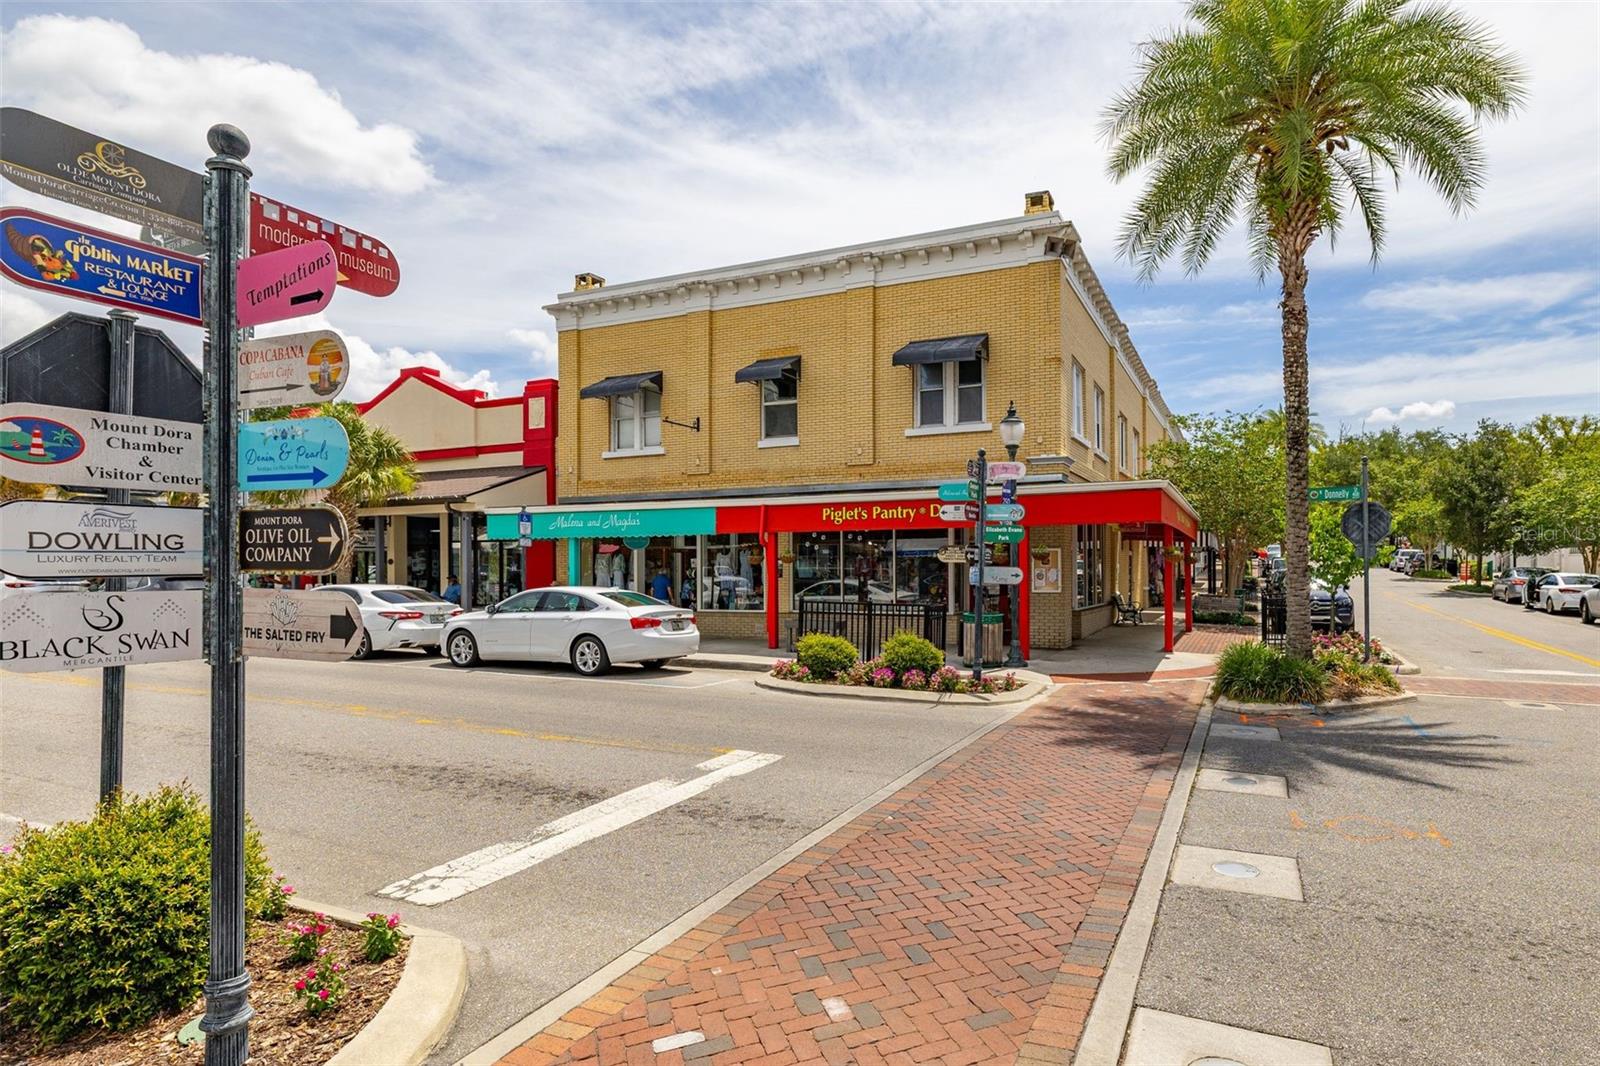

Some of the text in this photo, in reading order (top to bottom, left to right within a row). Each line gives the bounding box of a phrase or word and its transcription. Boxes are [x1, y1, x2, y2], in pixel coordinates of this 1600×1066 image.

[57, 162, 162, 204] OLDE MOUNT DORA
[73, 176, 147, 206] Carriage Company
[79, 235, 91, 245] the
[340, 252, 391, 280] museum
[85, 262, 186, 296] RESTAURANT
[247, 252, 331, 306] Temptations
[108, 279, 168, 301] & LOUNGE
[240, 345, 304, 366] COPACABANA
[90, 418, 192, 440] Mount Dora
[106, 436, 184, 455] Chamber
[245, 440, 328, 466] Denim & Pearls
[139, 455, 152, 468] &
[85, 466, 202, 485] Visitor Center
[79, 512, 138, 528] AMERIVEST
[254, 516, 302, 525] MOUNT DORA
[587, 514, 601, 528] and
[602, 512, 641, 531] Magda's
[822, 506, 868, 525] Piglet's
[872, 506, 917, 523] Pantry
[28, 531, 185, 550] DOWLING
[245, 528, 312, 544] OLIVE OIL
[37, 553, 177, 563] LUXURY REALTY TEAM
[245, 547, 312, 562] COMPANY
[0, 628, 191, 661] BLACK SWAN
[244, 627, 326, 643] THE SALTED FRY
[63, 655, 134, 666] MERCANTILE
